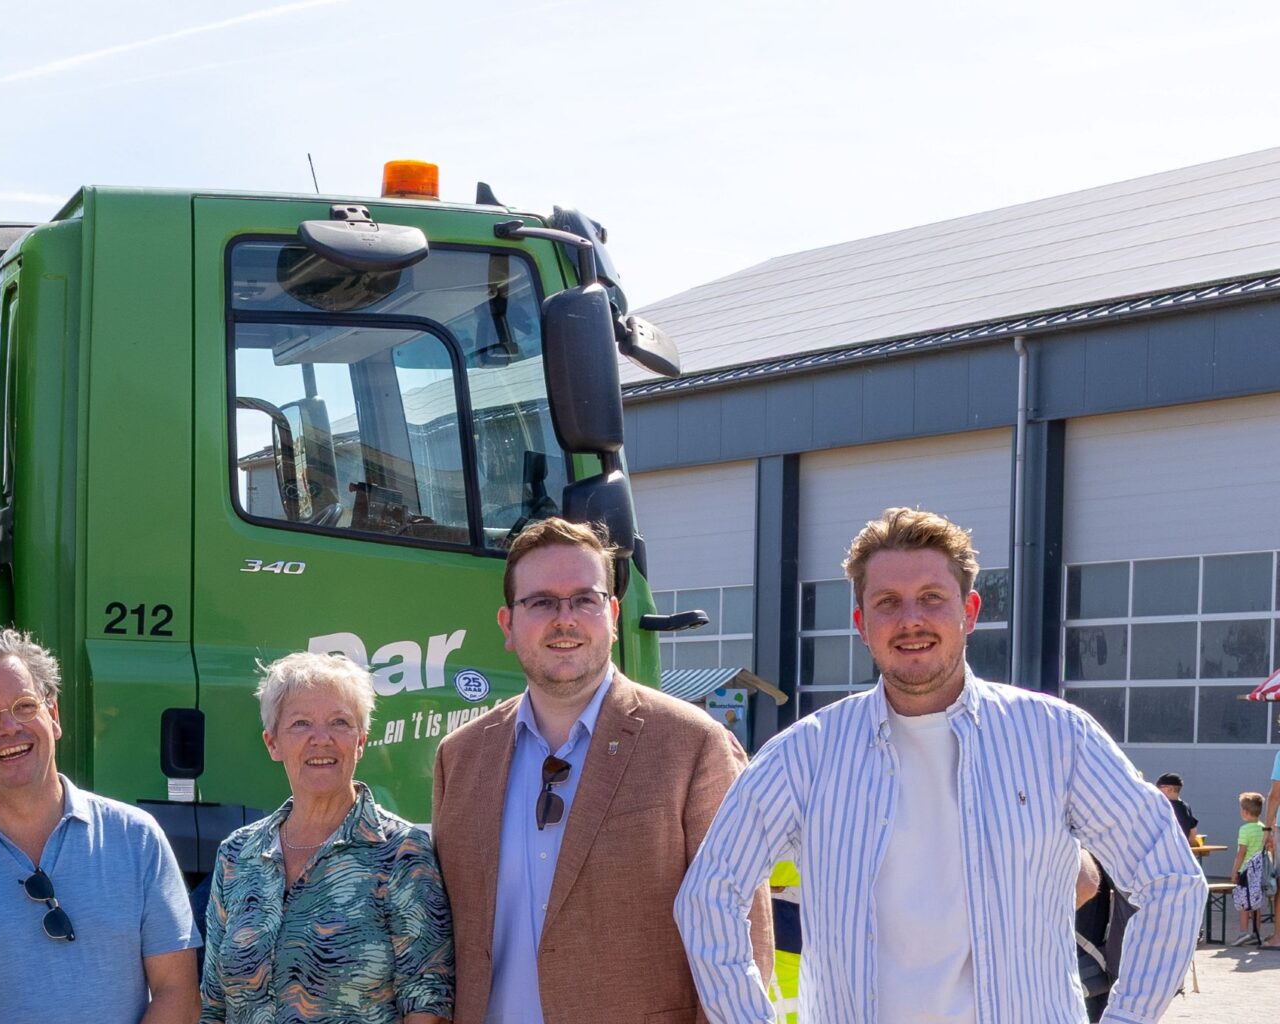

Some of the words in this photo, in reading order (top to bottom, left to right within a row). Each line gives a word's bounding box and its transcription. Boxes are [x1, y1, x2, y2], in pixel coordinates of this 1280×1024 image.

[239, 559, 306, 575] 340
[104, 602, 174, 637] 212
[462, 676, 482, 688] 25
[425, 710, 442, 738] is
